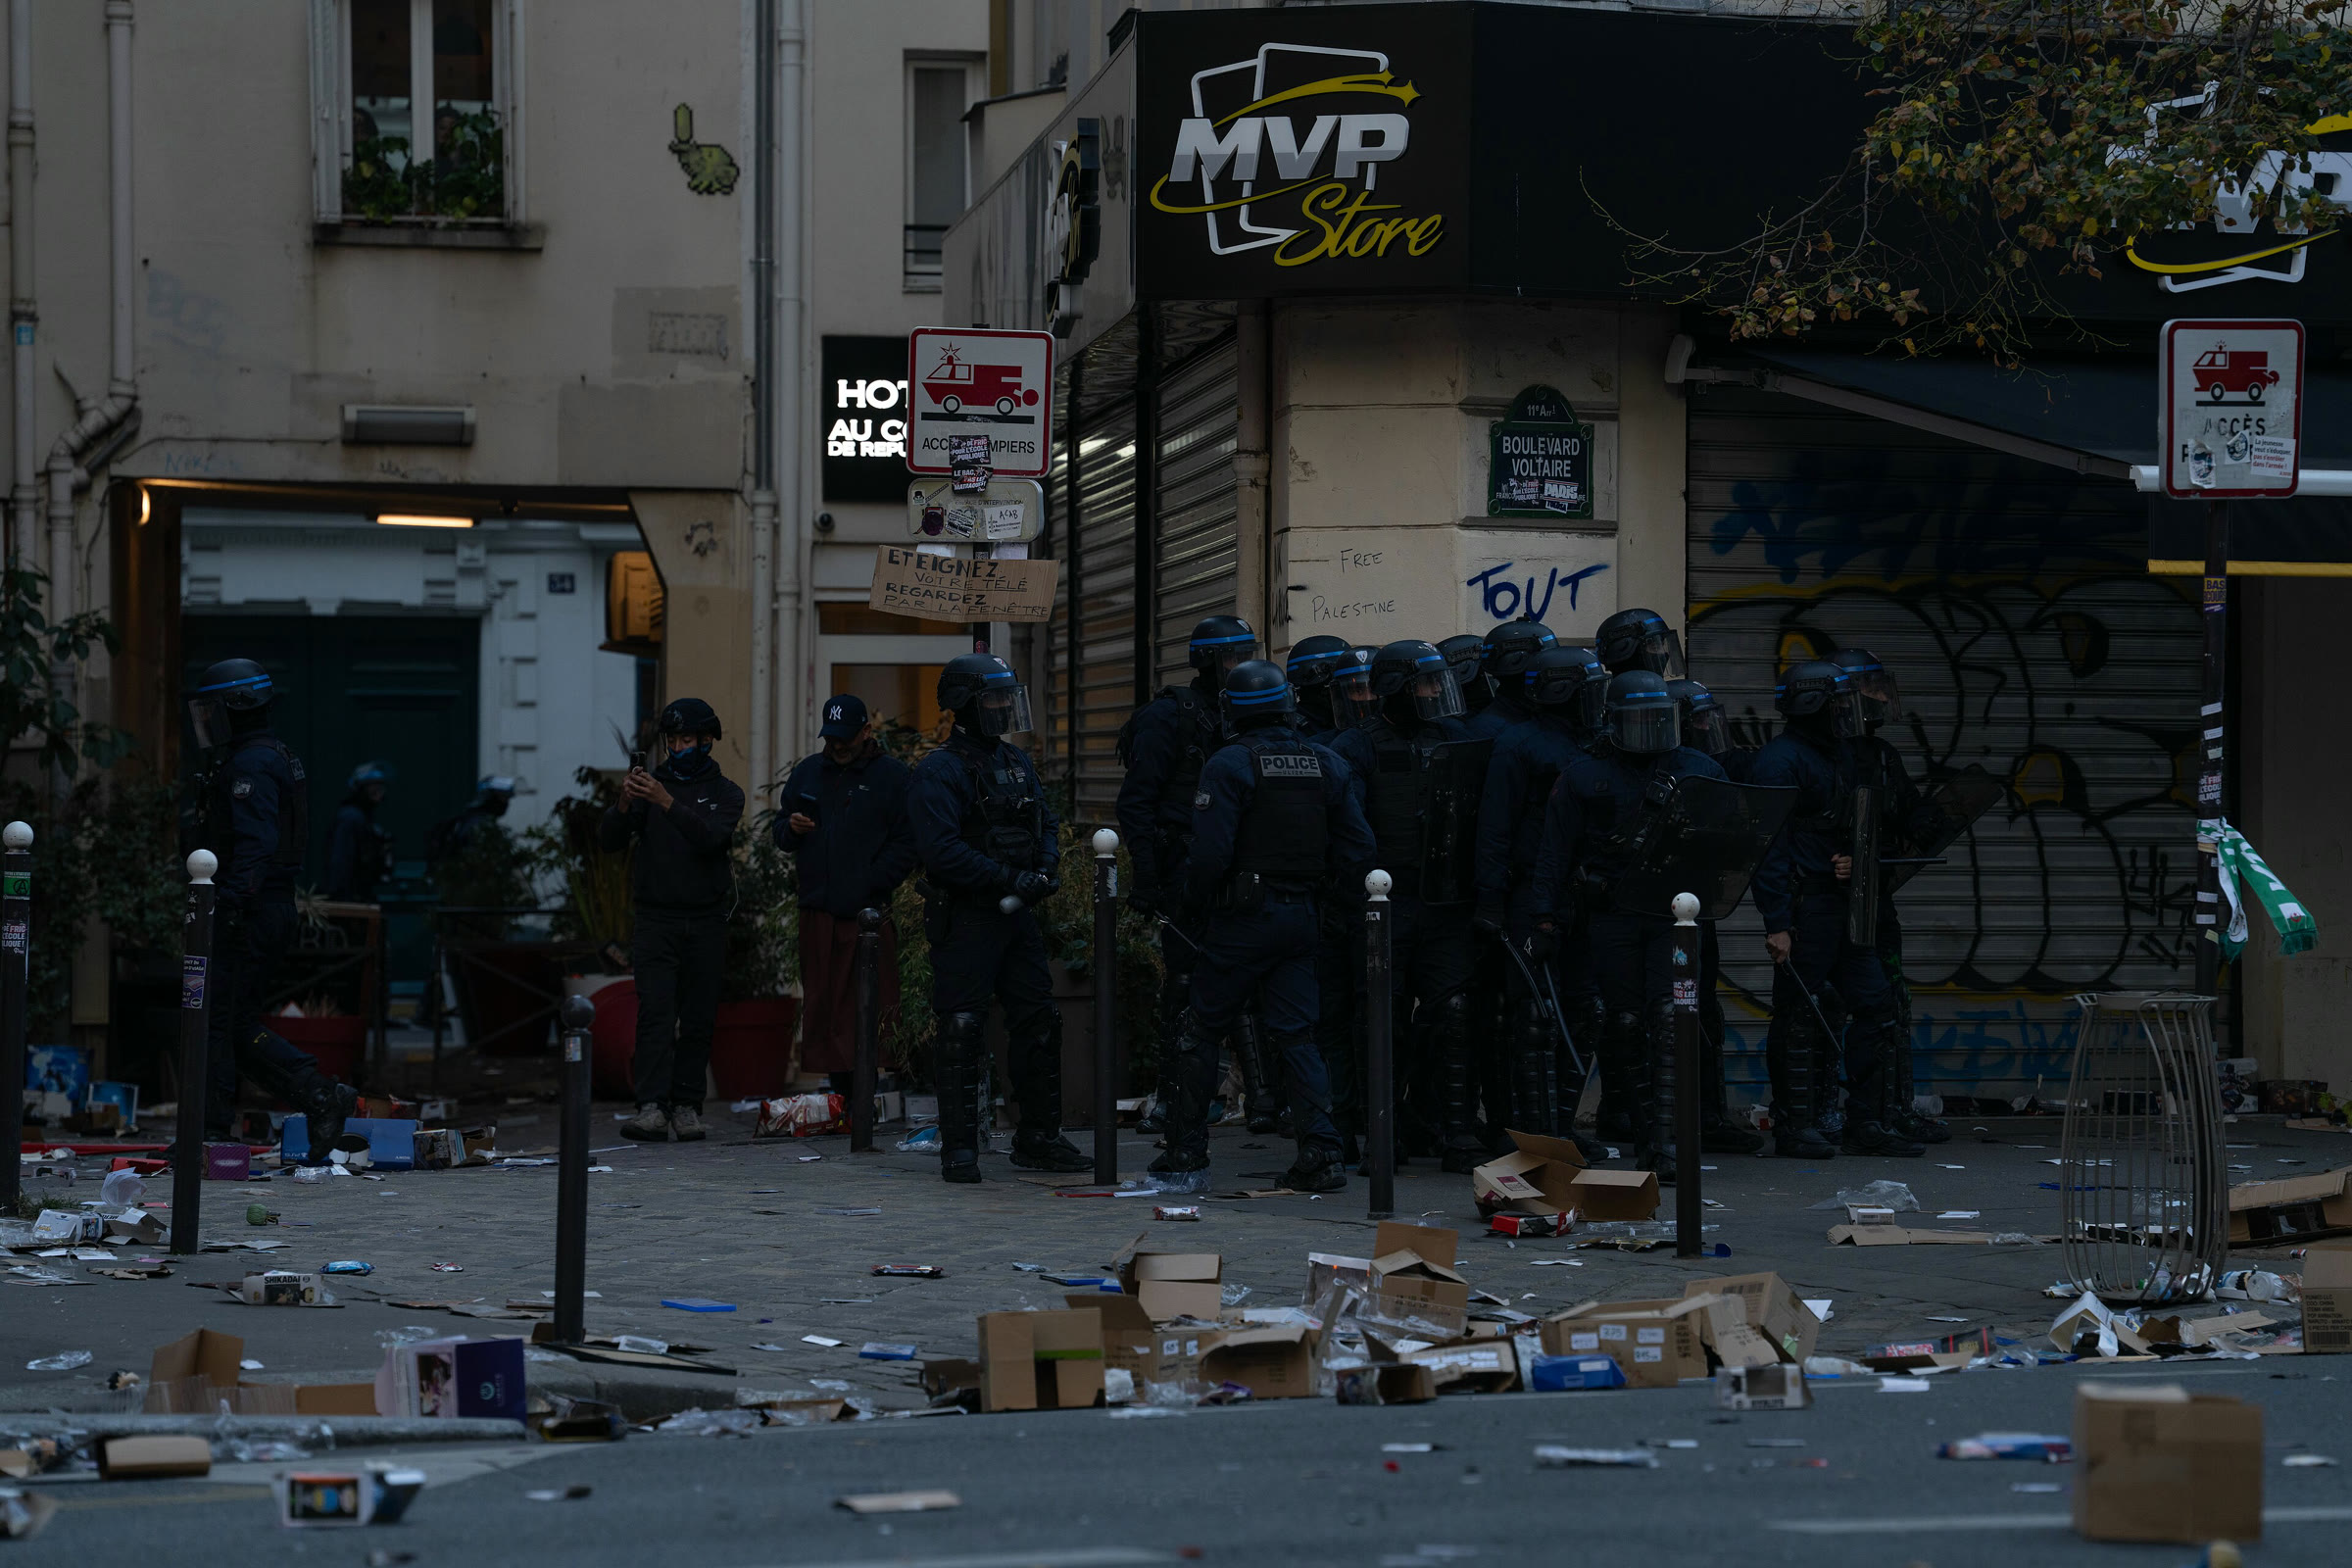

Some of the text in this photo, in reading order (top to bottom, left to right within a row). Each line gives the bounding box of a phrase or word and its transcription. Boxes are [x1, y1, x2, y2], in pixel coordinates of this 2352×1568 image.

[1168, 113, 1410, 182] MVP
[1274, 182, 1444, 268] Store
[827, 417, 872, 442] AU
[827, 440, 857, 457] DE
[922, 437, 1035, 454] ACC MPIERS
[1502, 435, 1581, 456] BOULEVARD
[2262, 438, 2284, 447] jeunesse
[1511, 457, 1572, 477] VOLTAIRE
[999, 509, 1019, 524] ACAB
[888, 548, 1000, 578] ETEIGNEZ
[1340, 548, 1384, 573] FREE
[914, 571, 1028, 590] VOTRE TÉLÉ
[886, 582, 987, 606] REGARDEZ
[1466, 563, 1611, 623] TOUT
[884, 594, 1049, 616] PAR LA FENÊTRE
[1311, 595, 1396, 623] PALESTINE
[1261, 757, 1319, 770] POLICE
